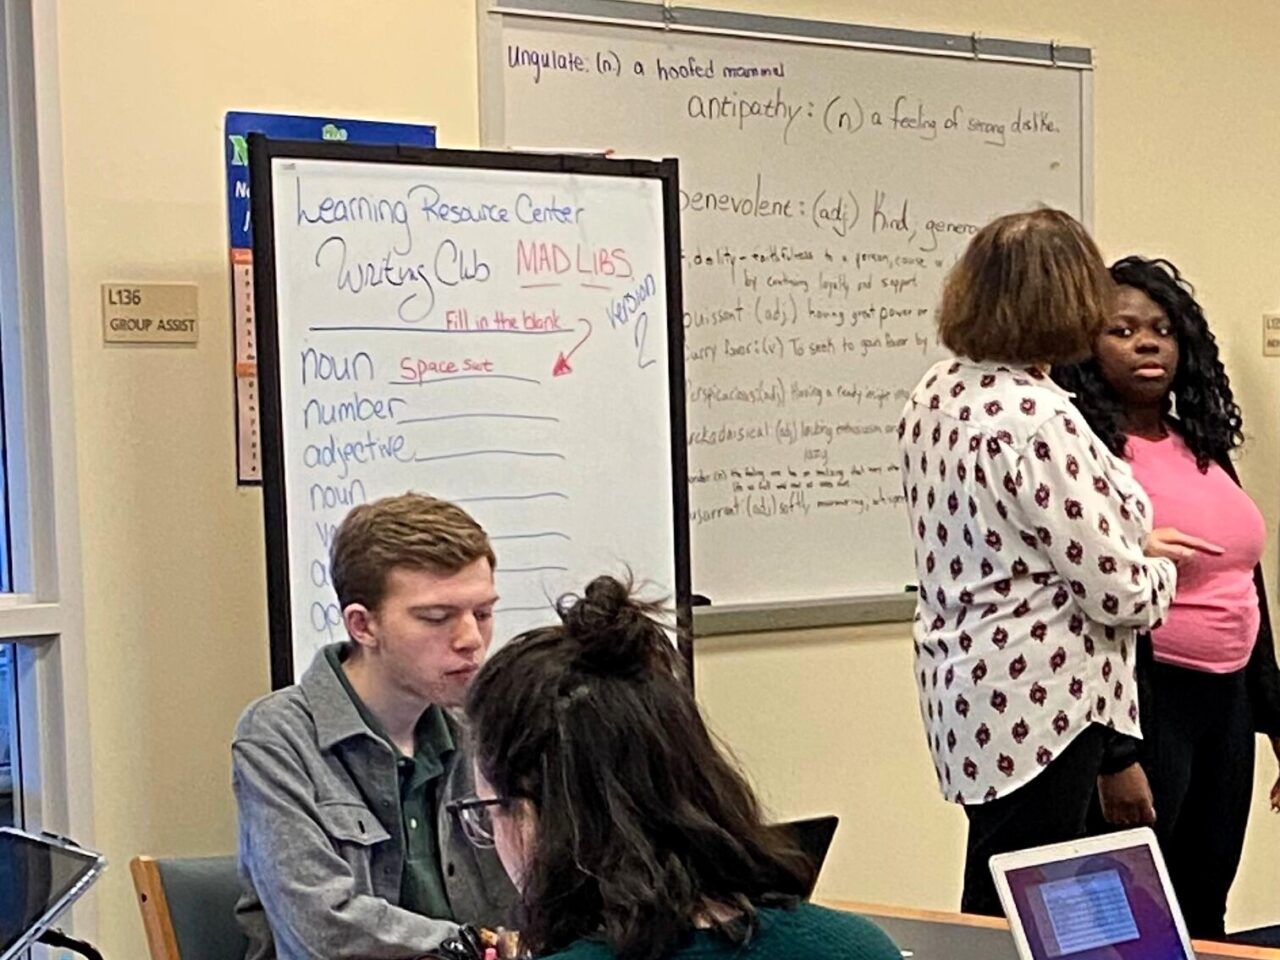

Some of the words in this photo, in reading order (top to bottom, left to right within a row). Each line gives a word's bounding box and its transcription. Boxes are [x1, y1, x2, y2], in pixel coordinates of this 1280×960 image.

[633, 62, 645, 76] a
[656, 56, 715, 81] hoofed
[823, 95, 865, 135] (n)
[871, 110, 884, 127] a
[889, 95, 938, 141] feeling
[943, 105, 963, 131] of
[967, 117, 1008, 147] strong
[296, 176, 413, 256] Learning
[407, 184, 509, 224] Resource
[515, 193, 586, 225] Center
[811, 190, 859, 238] (adj)
[925, 219, 984, 253] genero
[108, 288, 142, 306] L136
[315, 236, 436, 323] Writing
[434, 239, 491, 287] Club
[516, 239, 571, 276] MAD
[110, 318, 153, 332] GROUP
[157, 318, 196, 333] ASSIST
[446, 309, 469, 332] Fill
[476, 315, 489, 329] in
[493, 310, 520, 330] the
[522, 308, 562, 331] blank
[300, 347, 375, 387] noun
[687, 345, 718, 363] urry
[788, 337, 804, 357] To
[842, 336, 856, 354] to
[303, 390, 408, 430] number
[302, 430, 417, 480] adjective
[309, 478, 367, 512] noun
